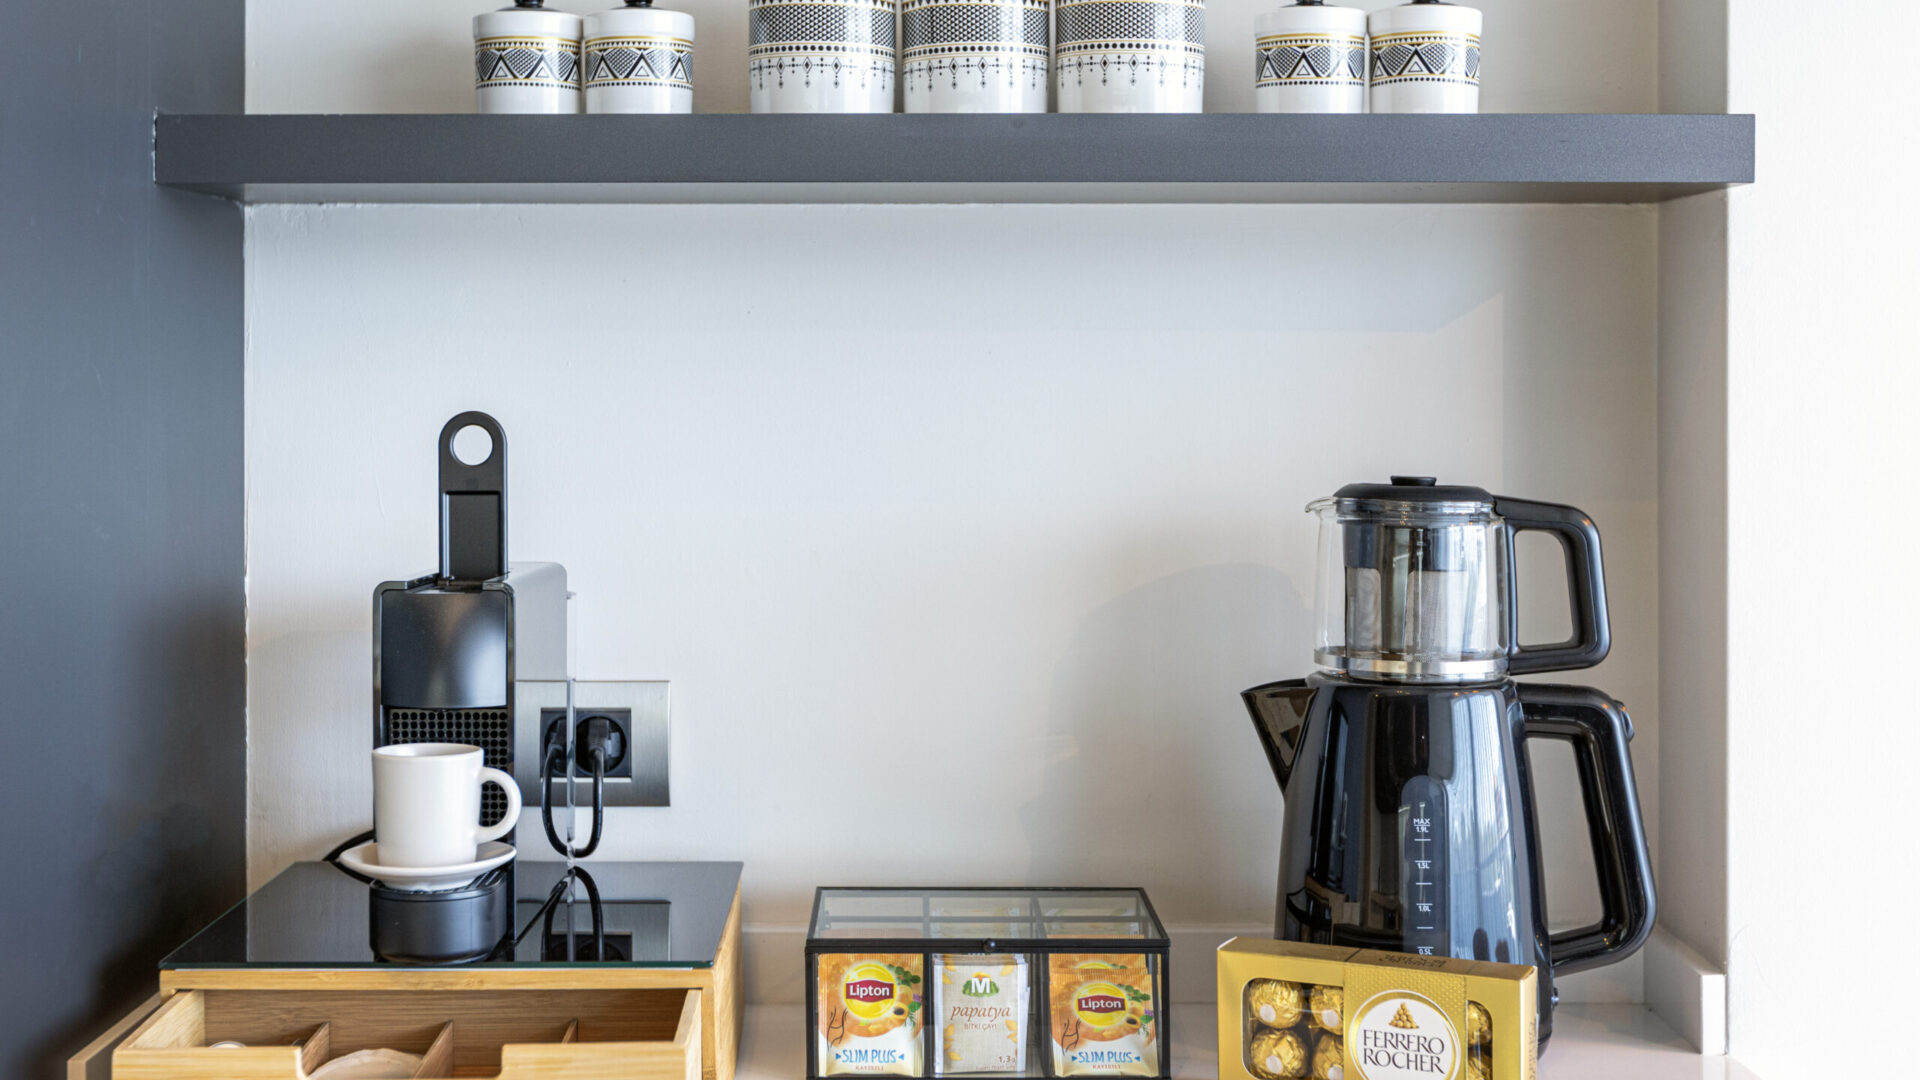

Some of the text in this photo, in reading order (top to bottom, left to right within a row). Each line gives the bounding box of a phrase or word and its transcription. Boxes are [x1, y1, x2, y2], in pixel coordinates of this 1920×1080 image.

[1418, 948, 1433, 956] 0.5L
[849, 984, 890, 999] Lipton
[971, 978, 991, 994] M
[1081, 998, 1122, 1010] Lipton
[950, 1005, 1011, 1023] papatya
[1363, 1029, 1446, 1056] FERRERO
[841, 1048, 897, 1064] SLIM PLUS
[1078, 1051, 1133, 1064] SLIM PLUS
[1363, 1047, 1446, 1075] ROCHER
